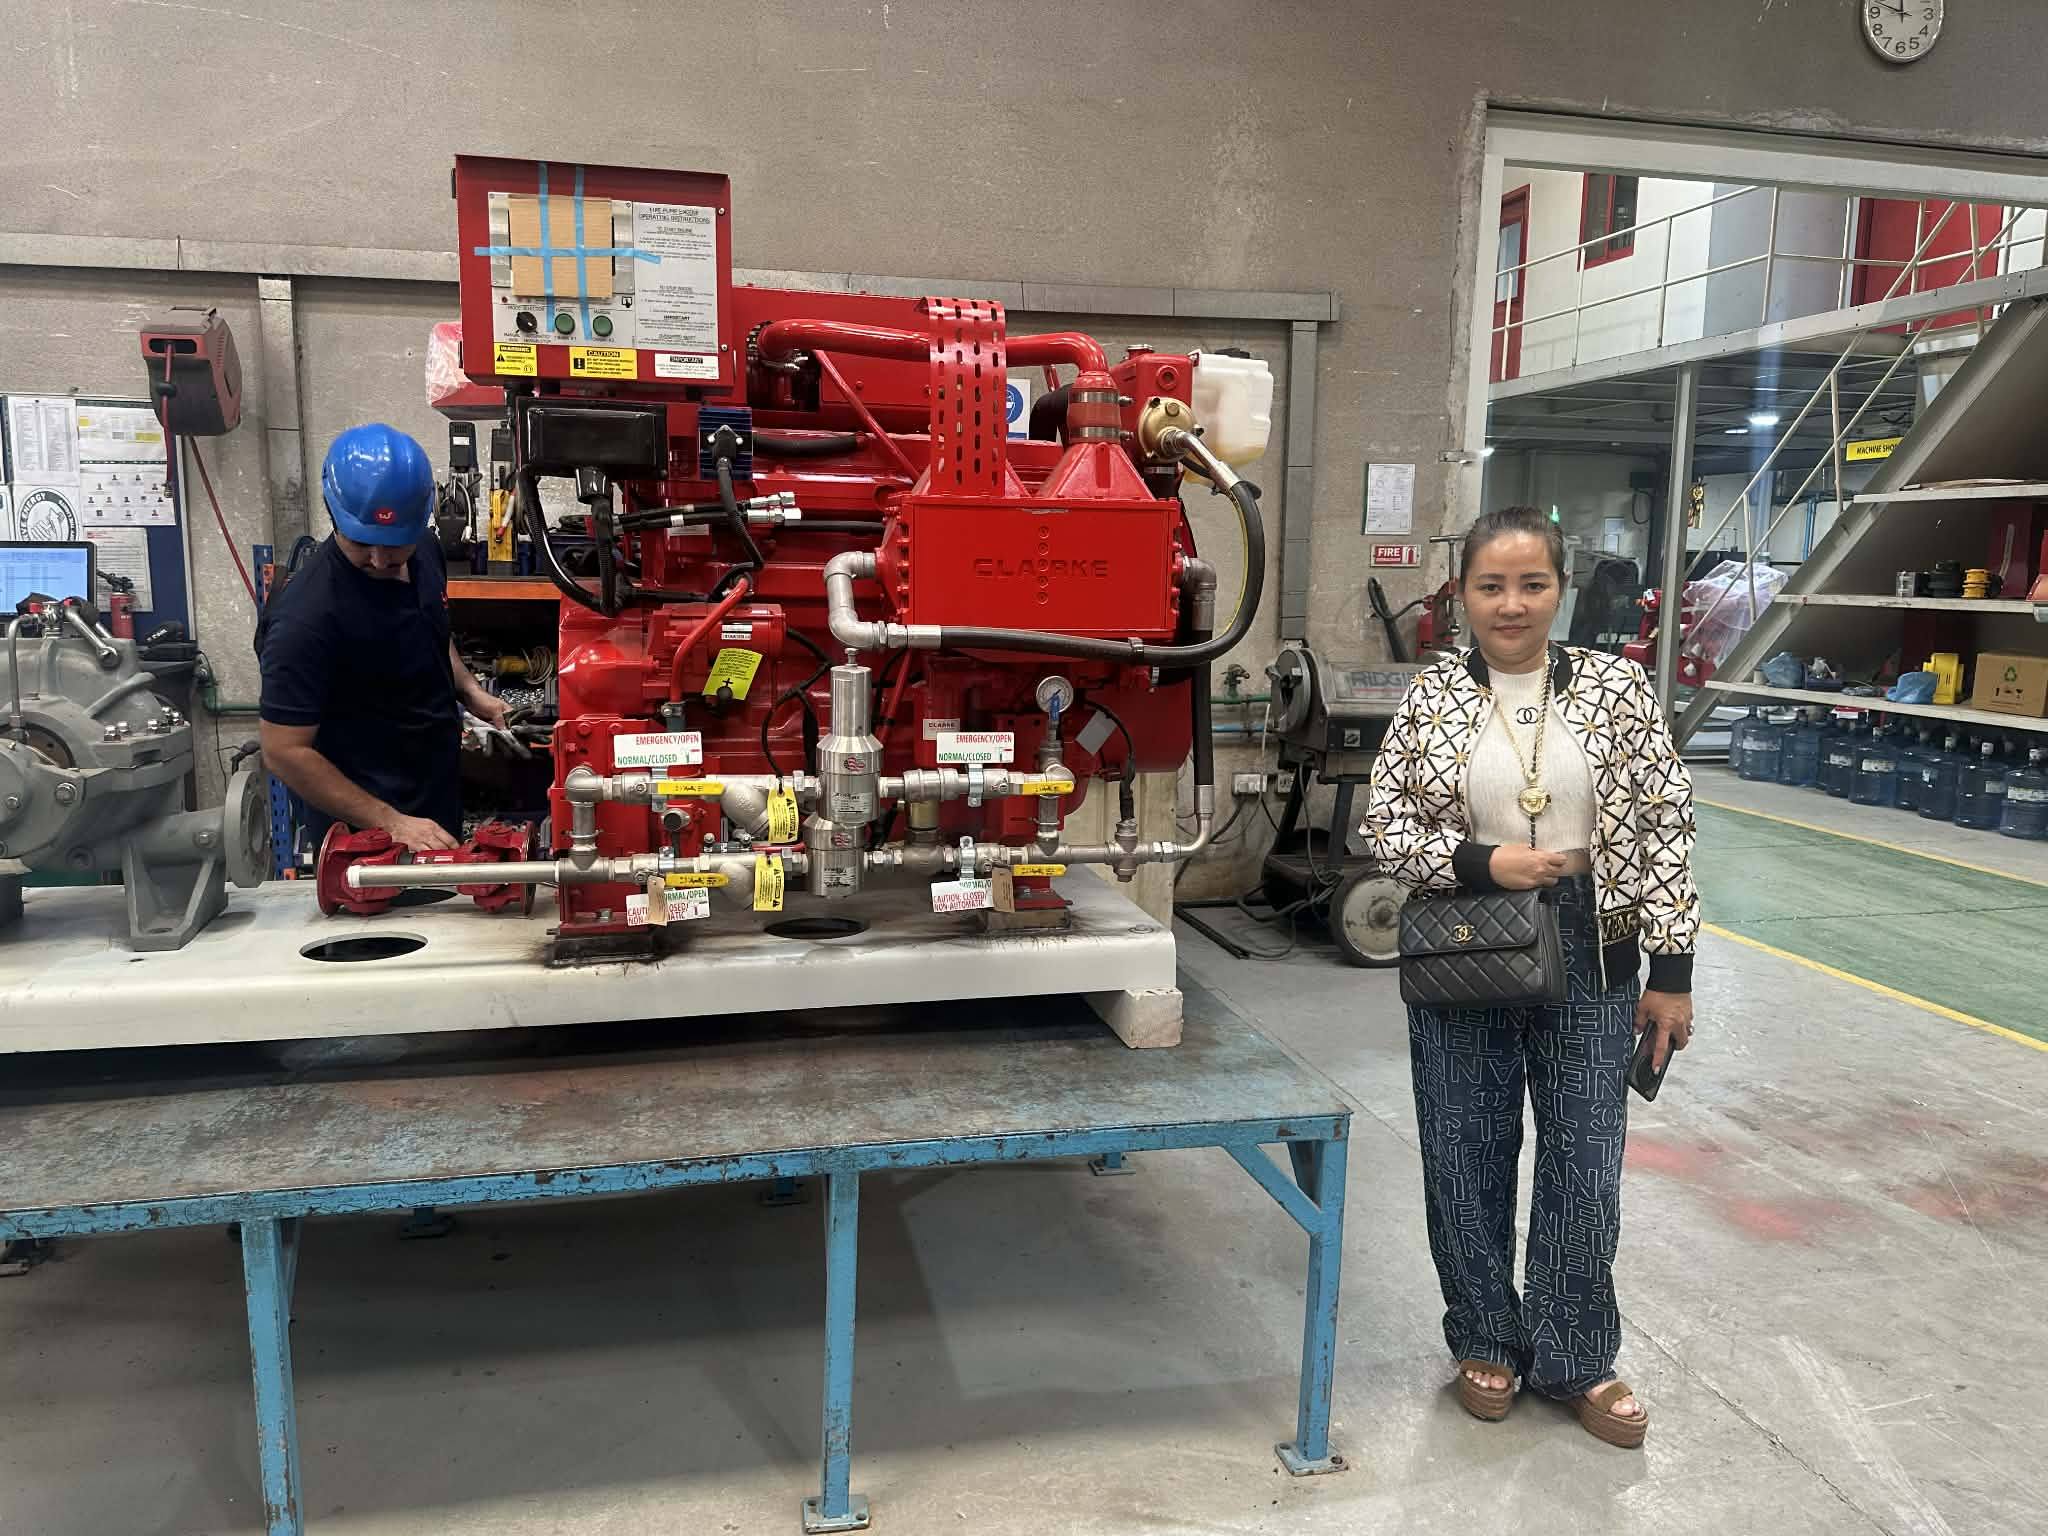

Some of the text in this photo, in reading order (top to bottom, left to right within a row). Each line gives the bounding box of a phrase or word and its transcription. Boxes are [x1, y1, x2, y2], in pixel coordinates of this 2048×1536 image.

[1870, 6, 1881, 19] 9
[1923, 7, 1934, 20] 3
[1872, 23, 1883, 36] 8
[1919, 25, 1929, 36] 4
[1881, 36, 1893, 49] 7
[1895, 41, 1906, 54] 6
[1909, 36, 1920, 49] 5
[1856, 445, 1882, 454] MACHINE
[1377, 547, 1401, 557] FIRE
[973, 557, 1109, 578] CLARKE
[1351, 671, 1412, 688] RIDGI
[635, 734, 700, 746] EMERGENCY/OPEN
[955, 734, 1012, 744] EMERGENCY/OPEN
[617, 753, 678, 766] NORMAL/CLOSED
[938, 752, 992, 762] NORMAL/CLOSED
